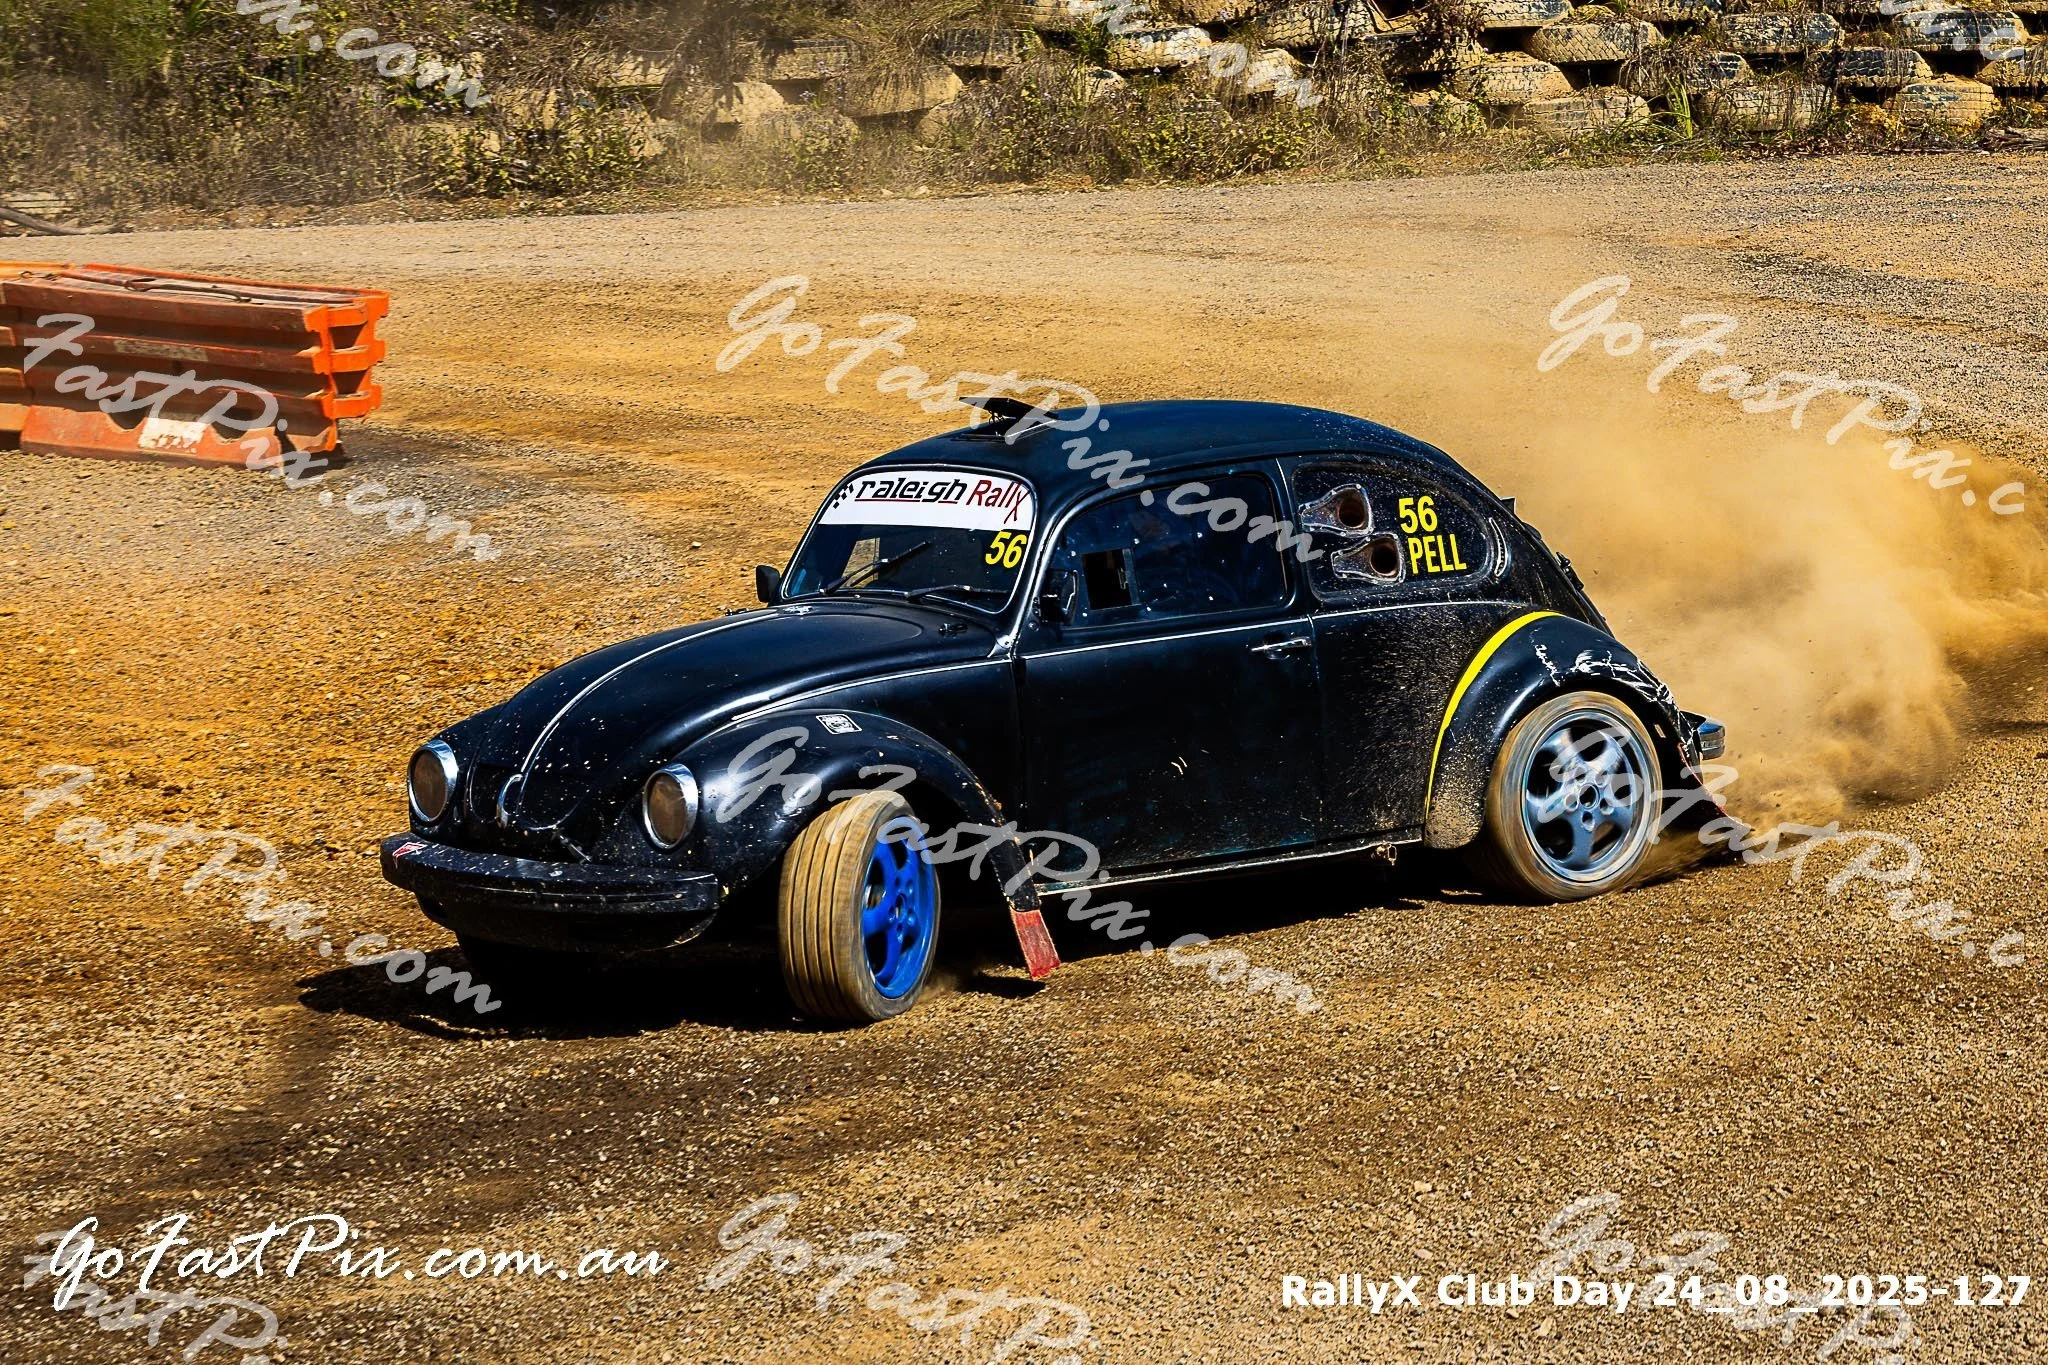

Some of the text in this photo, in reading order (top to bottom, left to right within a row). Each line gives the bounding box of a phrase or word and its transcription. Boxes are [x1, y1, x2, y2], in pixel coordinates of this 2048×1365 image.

[855, 477, 968, 503] raleigh
[1398, 495, 1438, 534] 56
[985, 530, 1028, 569] 56
[1407, 533, 1467, 575] PELL
